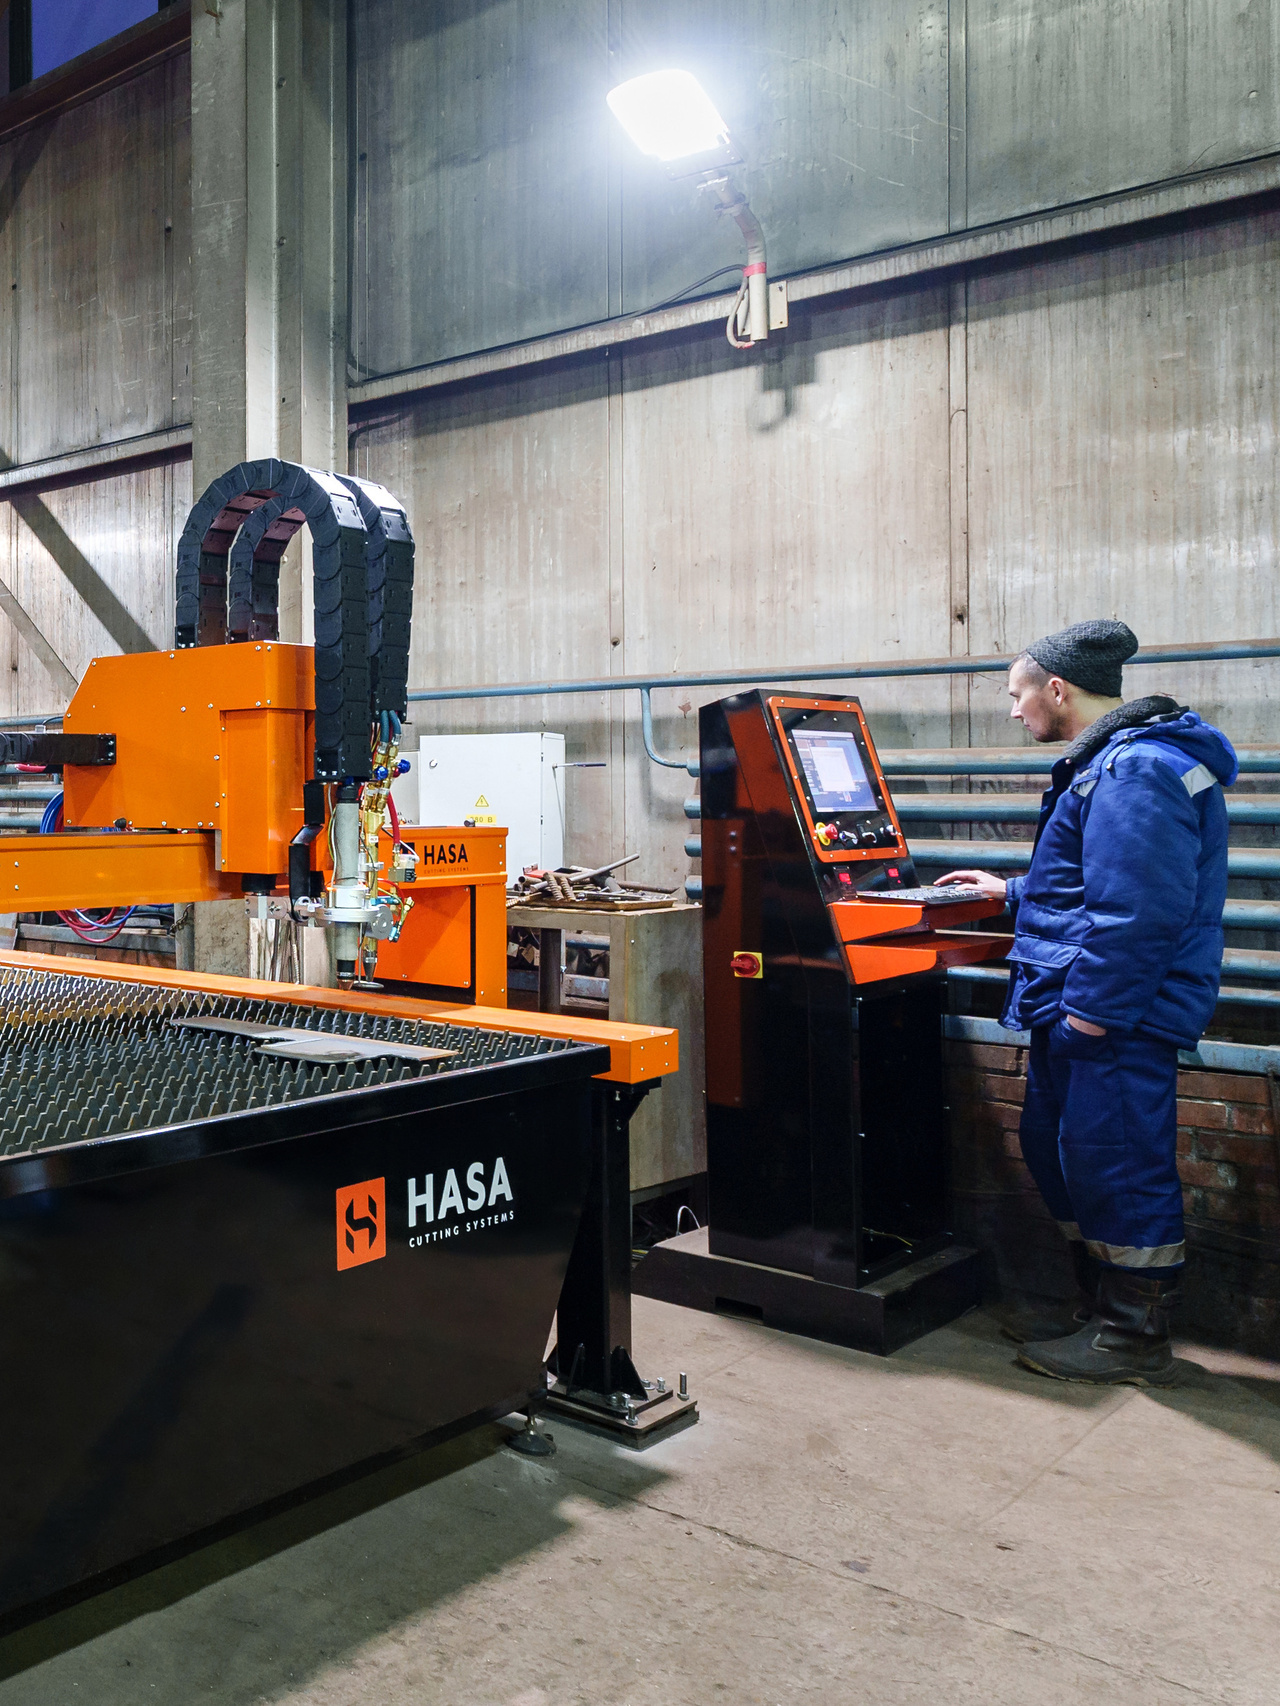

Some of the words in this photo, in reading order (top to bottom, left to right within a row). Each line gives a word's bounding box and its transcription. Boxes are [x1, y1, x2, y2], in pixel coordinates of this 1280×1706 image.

[424, 843, 468, 865] HASA
[407, 1156, 514, 1228] HASA
[409, 1225, 459, 1248] CUTTING
[465, 1210, 515, 1232] SYSTEMS
